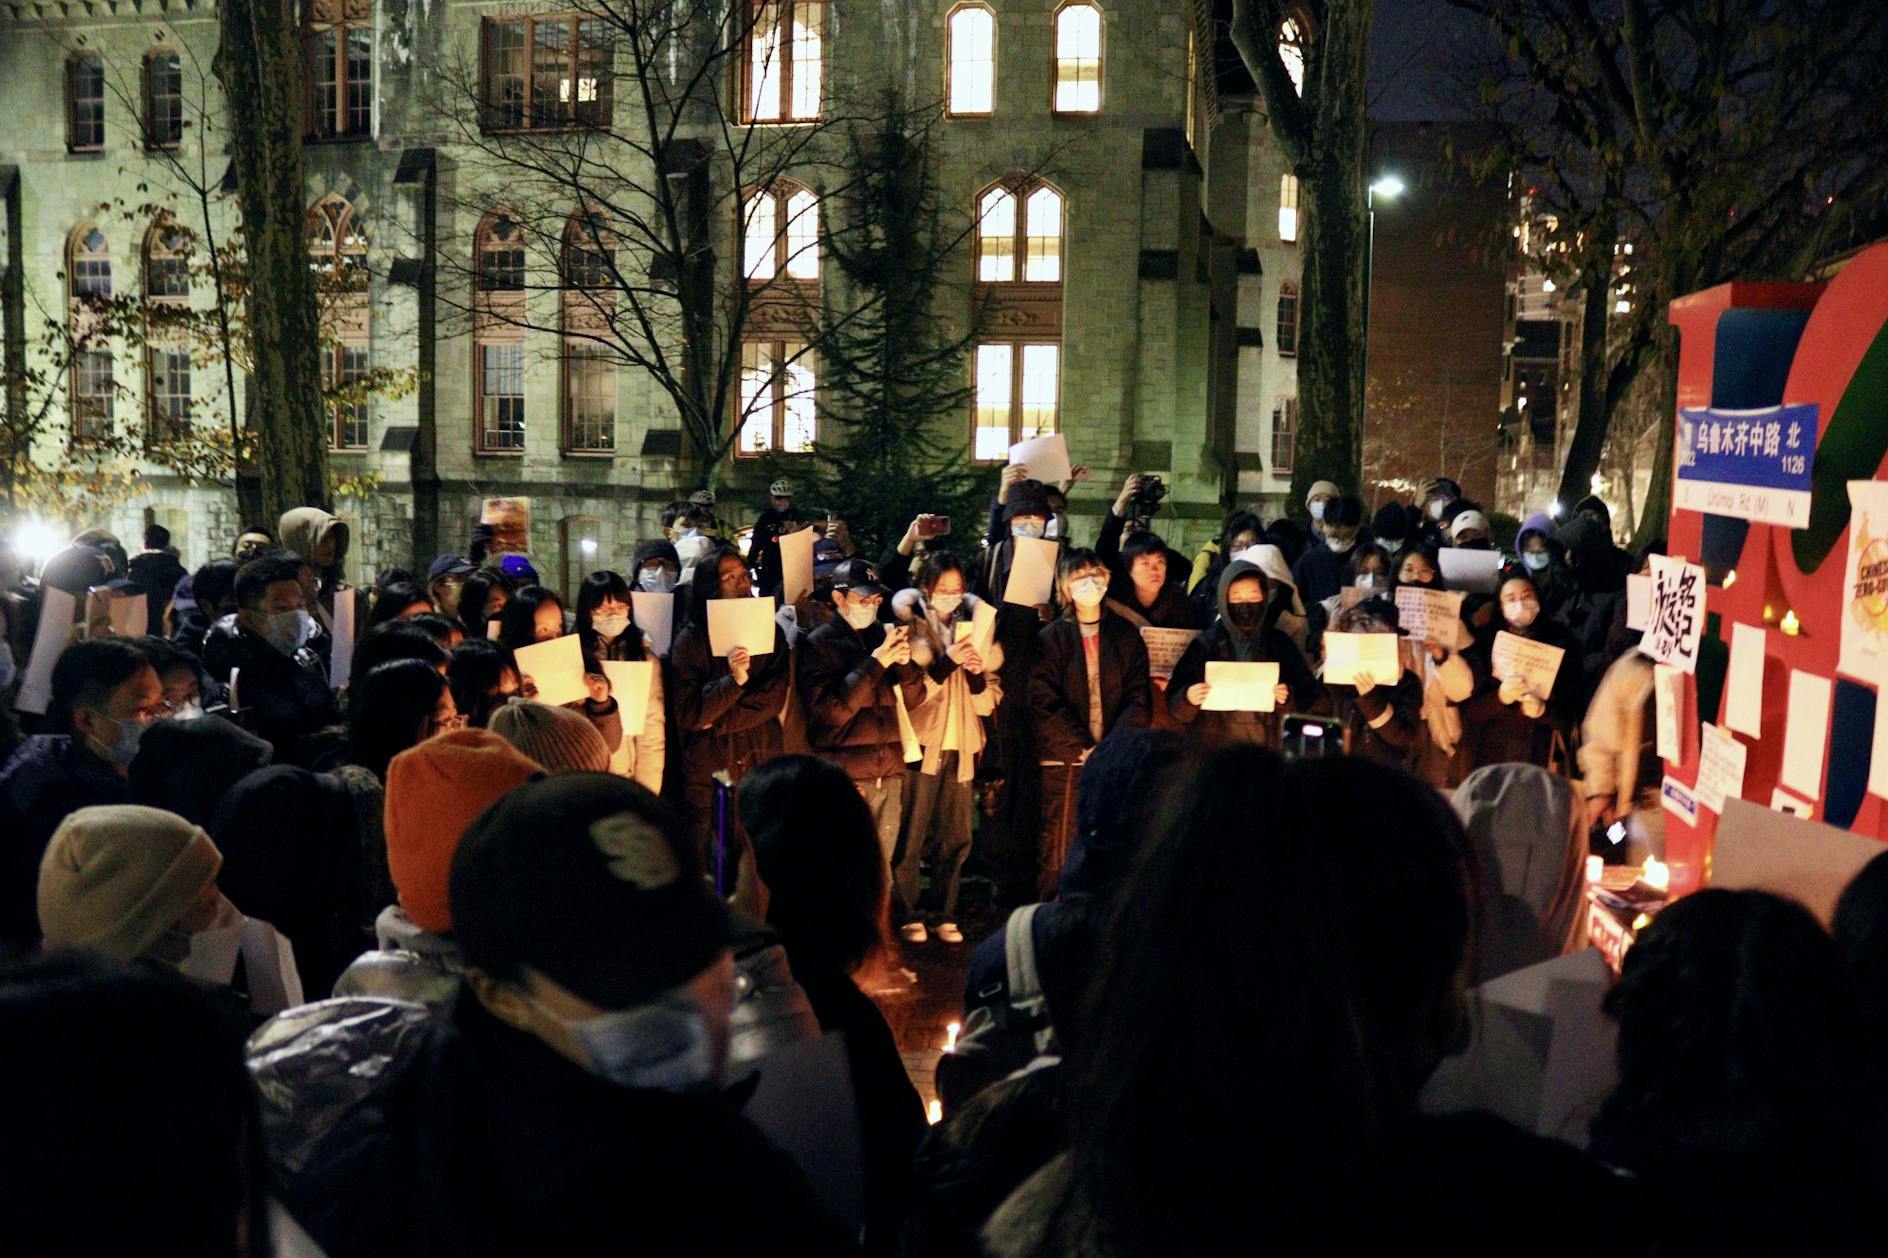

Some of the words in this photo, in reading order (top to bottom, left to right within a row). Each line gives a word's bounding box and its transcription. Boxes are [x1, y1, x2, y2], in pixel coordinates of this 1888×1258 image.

[1697, 420, 1781, 457] 乌鲁木齐中路
[1786, 421, 1801, 449] 北
[1781, 455, 1805, 475] 1126
